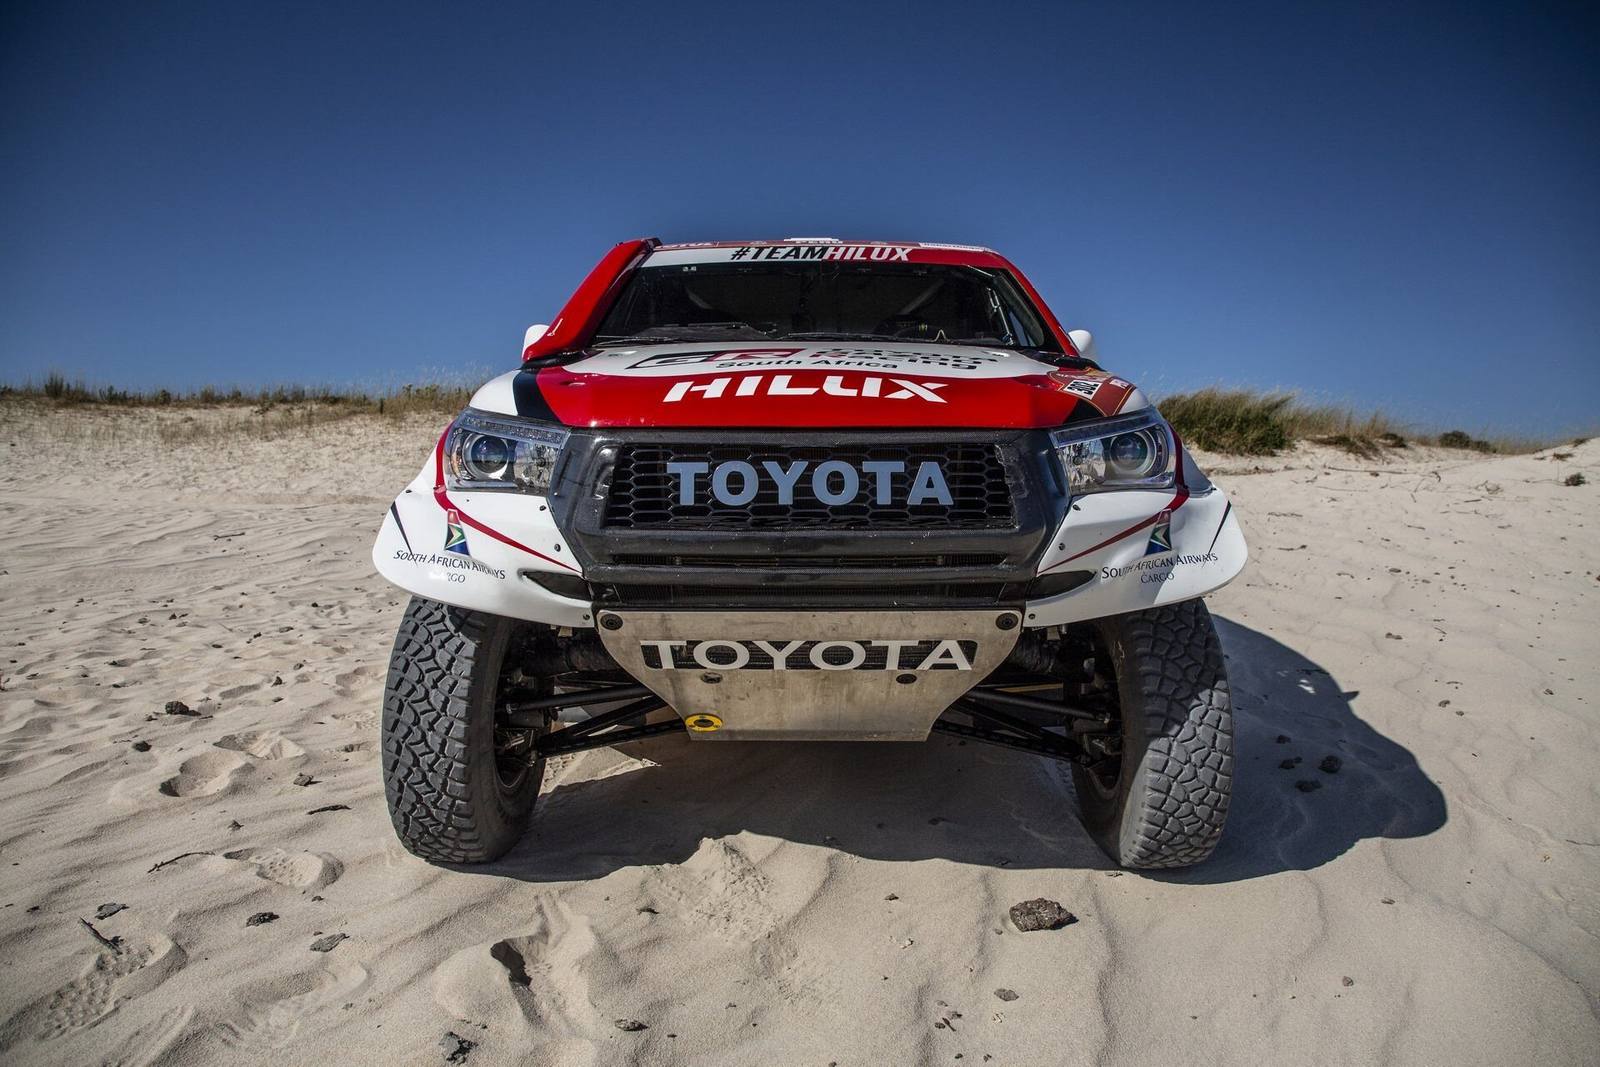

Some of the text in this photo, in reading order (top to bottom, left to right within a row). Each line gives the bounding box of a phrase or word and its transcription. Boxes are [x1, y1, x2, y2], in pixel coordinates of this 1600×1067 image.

[730, 246, 913, 262] #TEAMHILUX
[715, 359, 898, 369] South Africa
[662, 375, 949, 404] HILUX
[666, 460, 955, 507] TOYOTA
[393, 550, 426, 564] SOUTH
[428, 553, 470, 570] AFRICAN
[1134, 557, 1174, 571] AFRICAN
[1176, 553, 1218, 566] AIRWAYS
[1140, 572, 1175, 584] CARGO
[640, 640, 972, 671] TOYOTA
